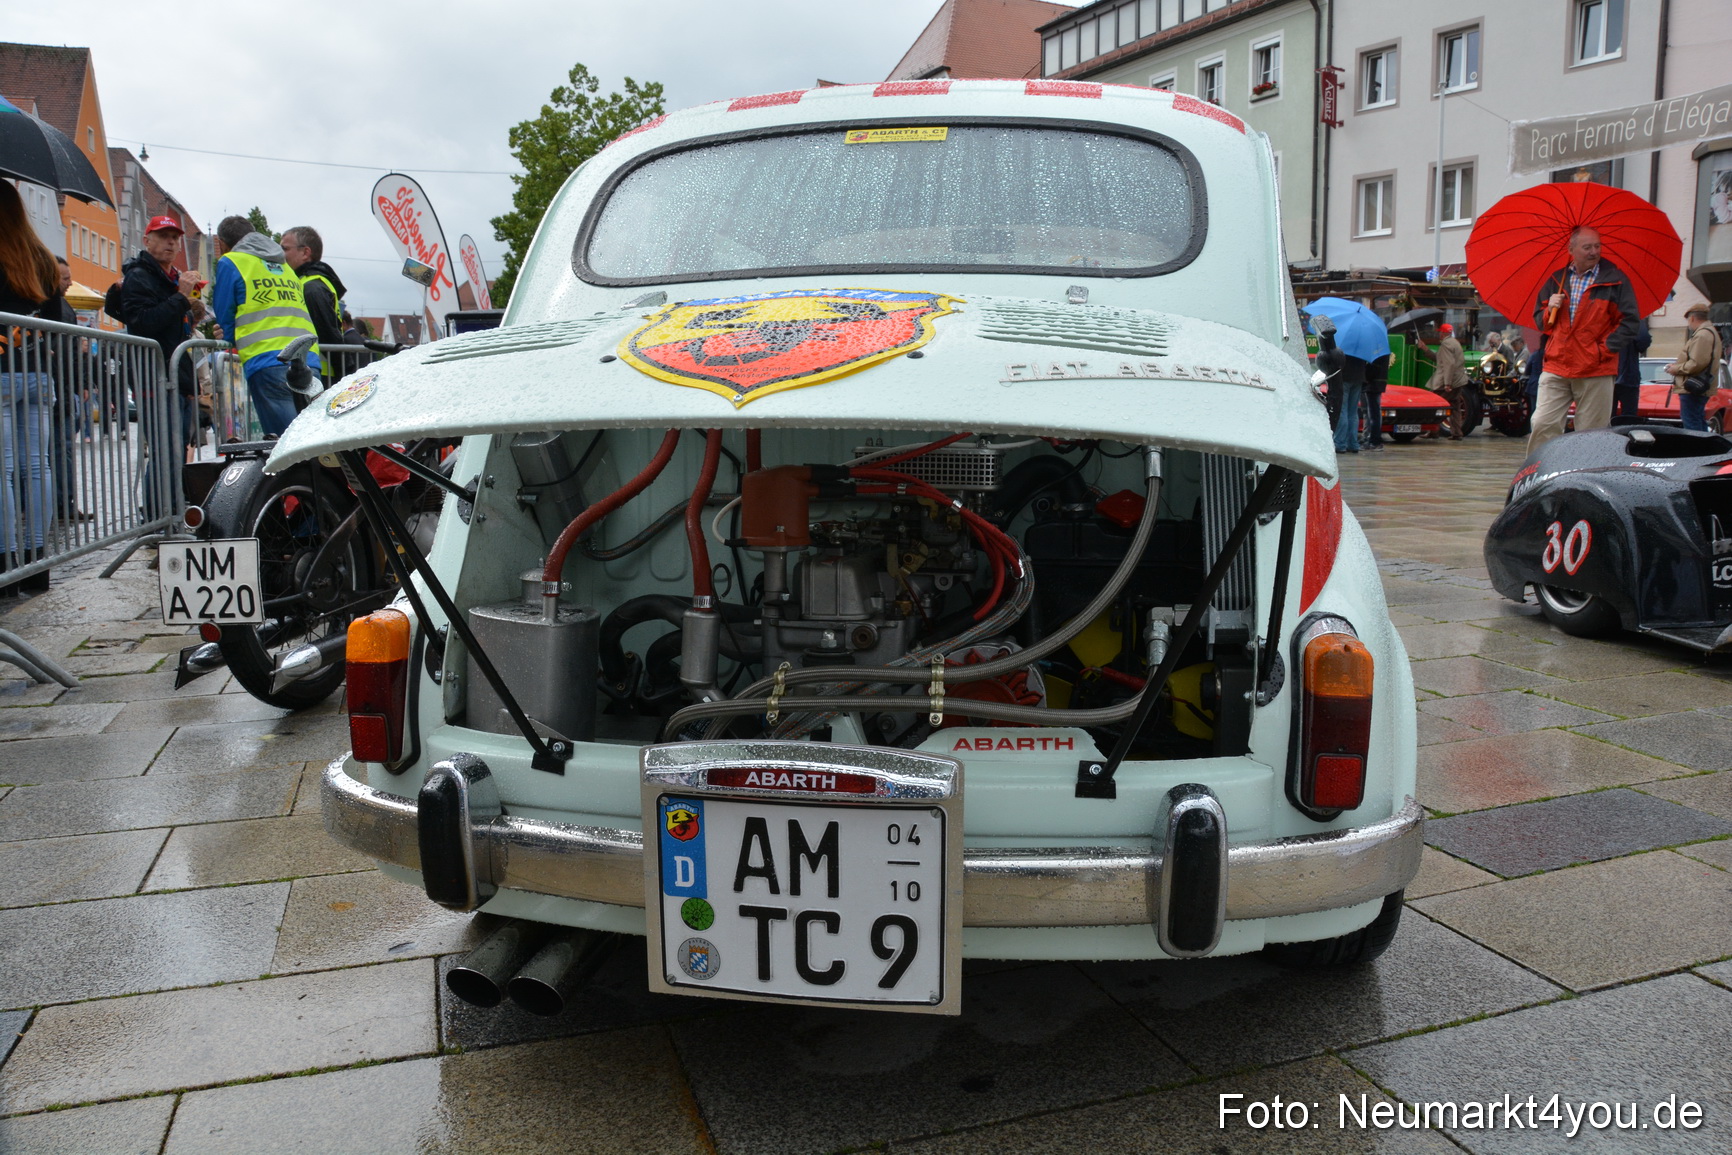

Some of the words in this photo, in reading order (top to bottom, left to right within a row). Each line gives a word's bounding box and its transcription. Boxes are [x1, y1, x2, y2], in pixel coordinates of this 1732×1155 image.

[1324, 79, 1335, 120] Achatz
[1531, 128, 1568, 161] Parc
[1573, 107, 1639, 152] Fermé
[1643, 95, 1732, 138] d'Eléga
[277, 290, 297, 302] ME
[1005, 361, 1088, 379] FIAT
[1116, 361, 1265, 386] ABARTH
[186, 546, 235, 581] NM
[1542, 519, 1592, 576] 30
[168, 586, 192, 619] A
[196, 584, 256, 619] 220
[952, 737, 1074, 751] ABARTH
[744, 771, 837, 789] ABARTH
[670, 803, 695, 813] ABARTH
[887, 823, 921, 846] 04
[674, 855, 695, 888] D
[733, 816, 840, 899] AM
[889, 880, 921, 902] 10
[739, 904, 847, 987] TC
[870, 914, 919, 989] 9
